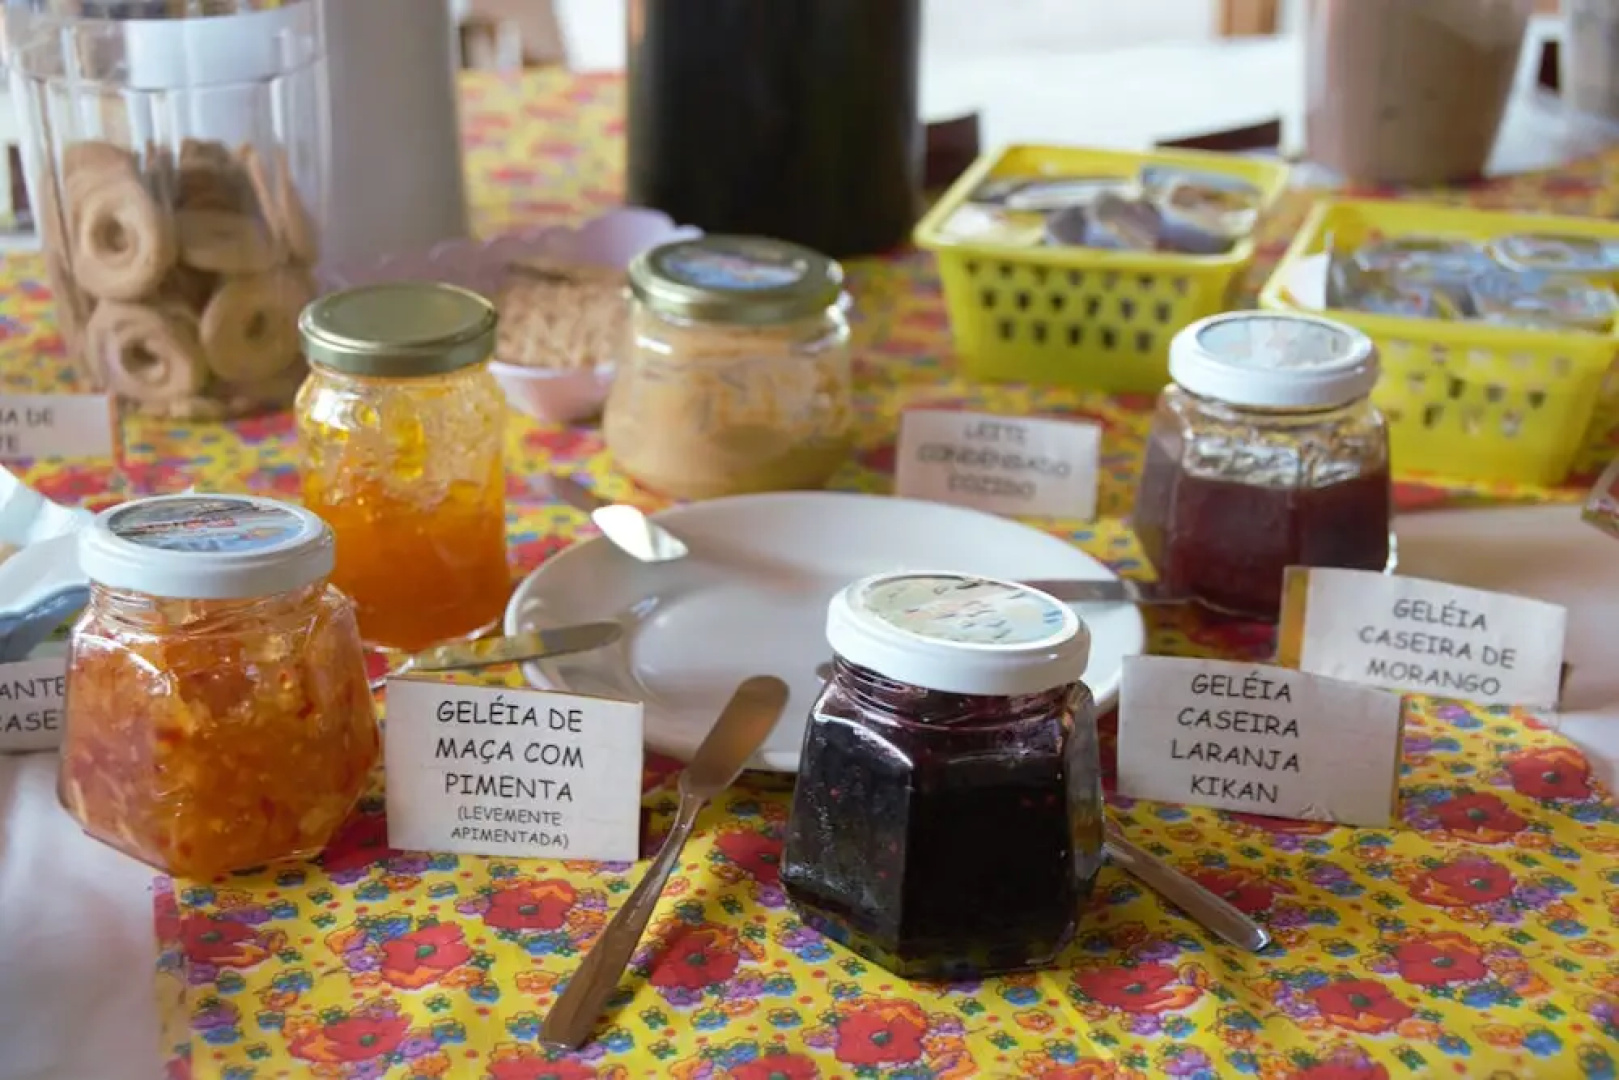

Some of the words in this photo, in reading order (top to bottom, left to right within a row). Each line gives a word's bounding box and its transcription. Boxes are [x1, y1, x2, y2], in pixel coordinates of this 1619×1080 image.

[1393, 599, 1487, 631] GELÉIA
[1358, 625, 1472, 660] CASEIRA
[1481, 646, 1516, 669] DE
[1191, 670, 1291, 703] GELÉIA
[1366, 658, 1501, 696] MORANGO
[436, 695, 538, 727] GELÉIA
[549, 707, 583, 733] DE
[1177, 707, 1299, 738] CASEIRA
[434, 737, 514, 765] MAÇA
[524, 742, 584, 769] COM
[1170, 738, 1300, 773] LARANJA
[444, 772, 573, 803] PIMENTA
[1190, 774, 1278, 804] KIKAN
[457, 805, 562, 826] (LEVEMENTE
[450, 827, 570, 849] APIMENTADA)
